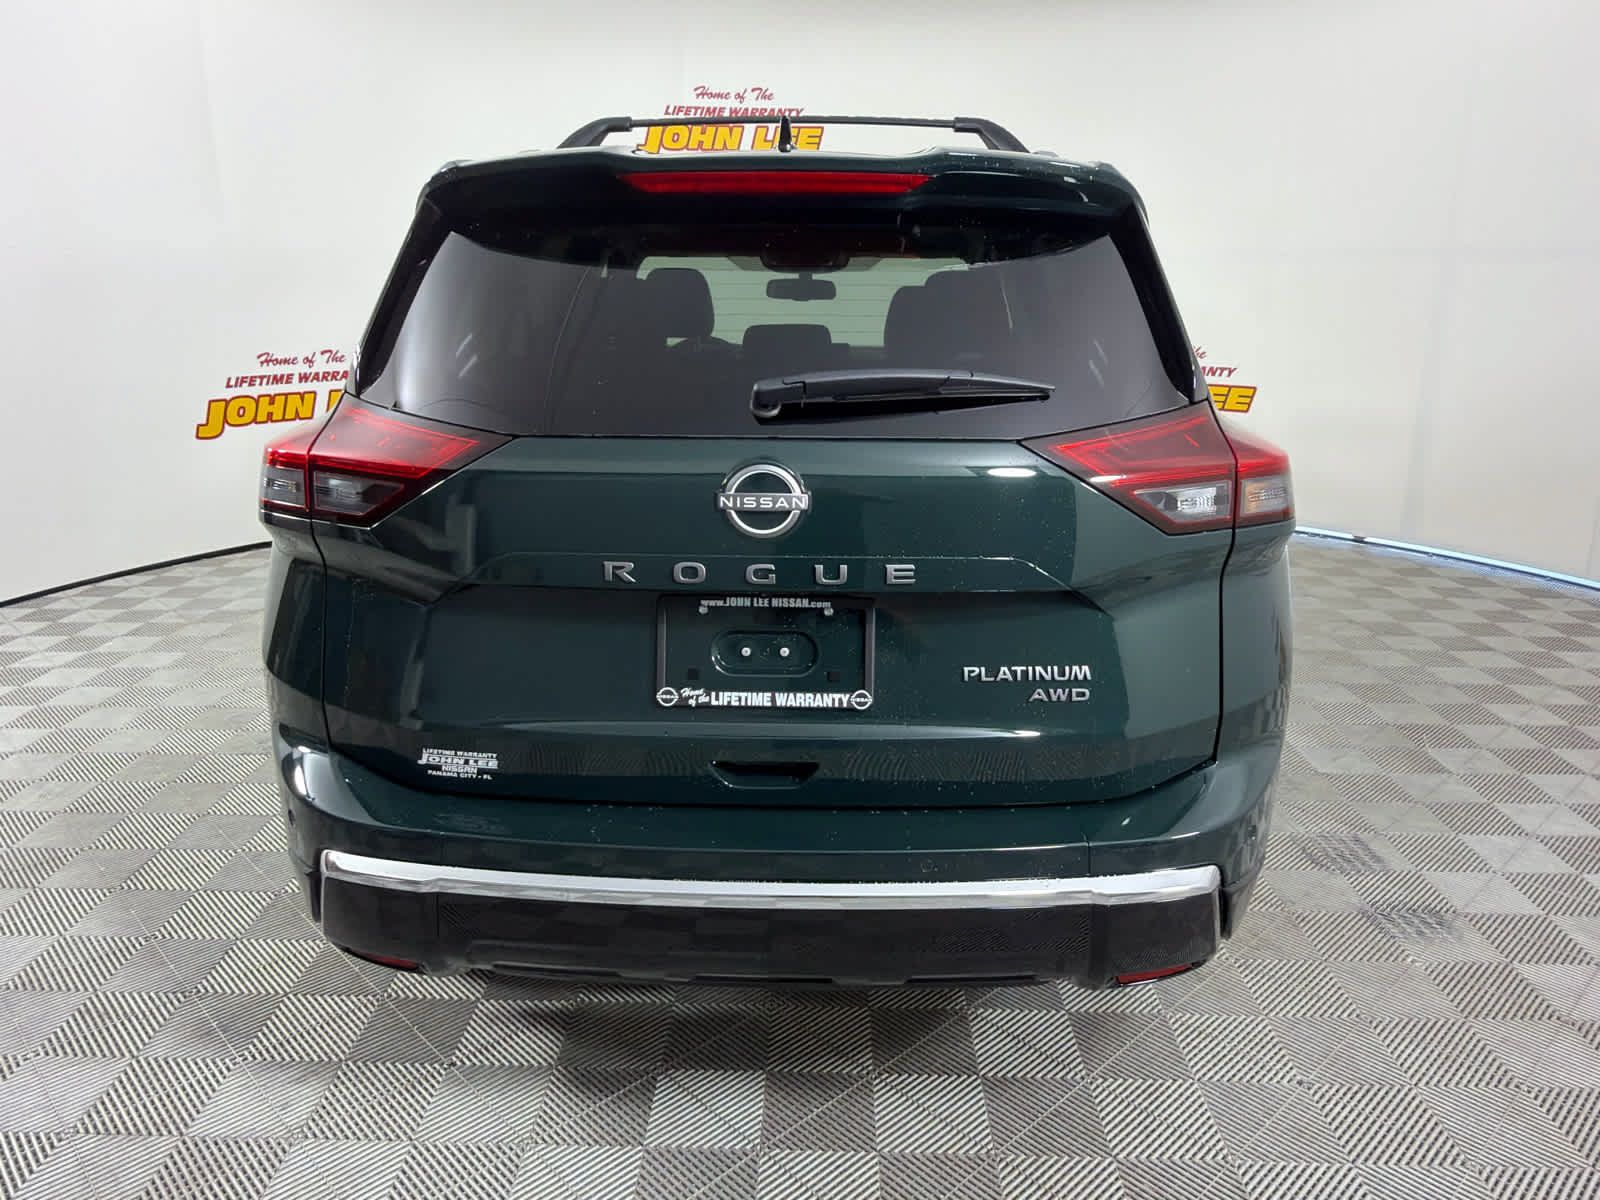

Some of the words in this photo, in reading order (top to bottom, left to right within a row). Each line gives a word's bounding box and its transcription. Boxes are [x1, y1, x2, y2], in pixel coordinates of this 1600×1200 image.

[694, 85, 731, 100] Home
[734, 87, 747, 104] of
[751, 87, 774, 101] The
[664, 104, 726, 117] LIFETIME
[729, 106, 804, 118] WARRANTY
[636, 123, 744, 154] JOHN
[256, 351, 299, 368] Home
[302, 351, 317, 369] of
[320, 349, 346, 365] The
[225, 373, 293, 389] LIFETIME
[297, 370, 350, 384] WARRA
[1201, 366, 1237, 377] ANTY
[1207, 384, 1256, 413] EE
[195, 390, 317, 440] JOHN
[720, 496, 806, 509] NISSAN
[602, 560, 917, 586] ROGUE
[963, 665, 1092, 681] PLATINUM
[711, 691, 772, 706] LIFETIME
[775, 692, 850, 707] WARRANTY
[1028, 688, 1090, 701] AWD
[417, 753, 465, 765] JOHN
